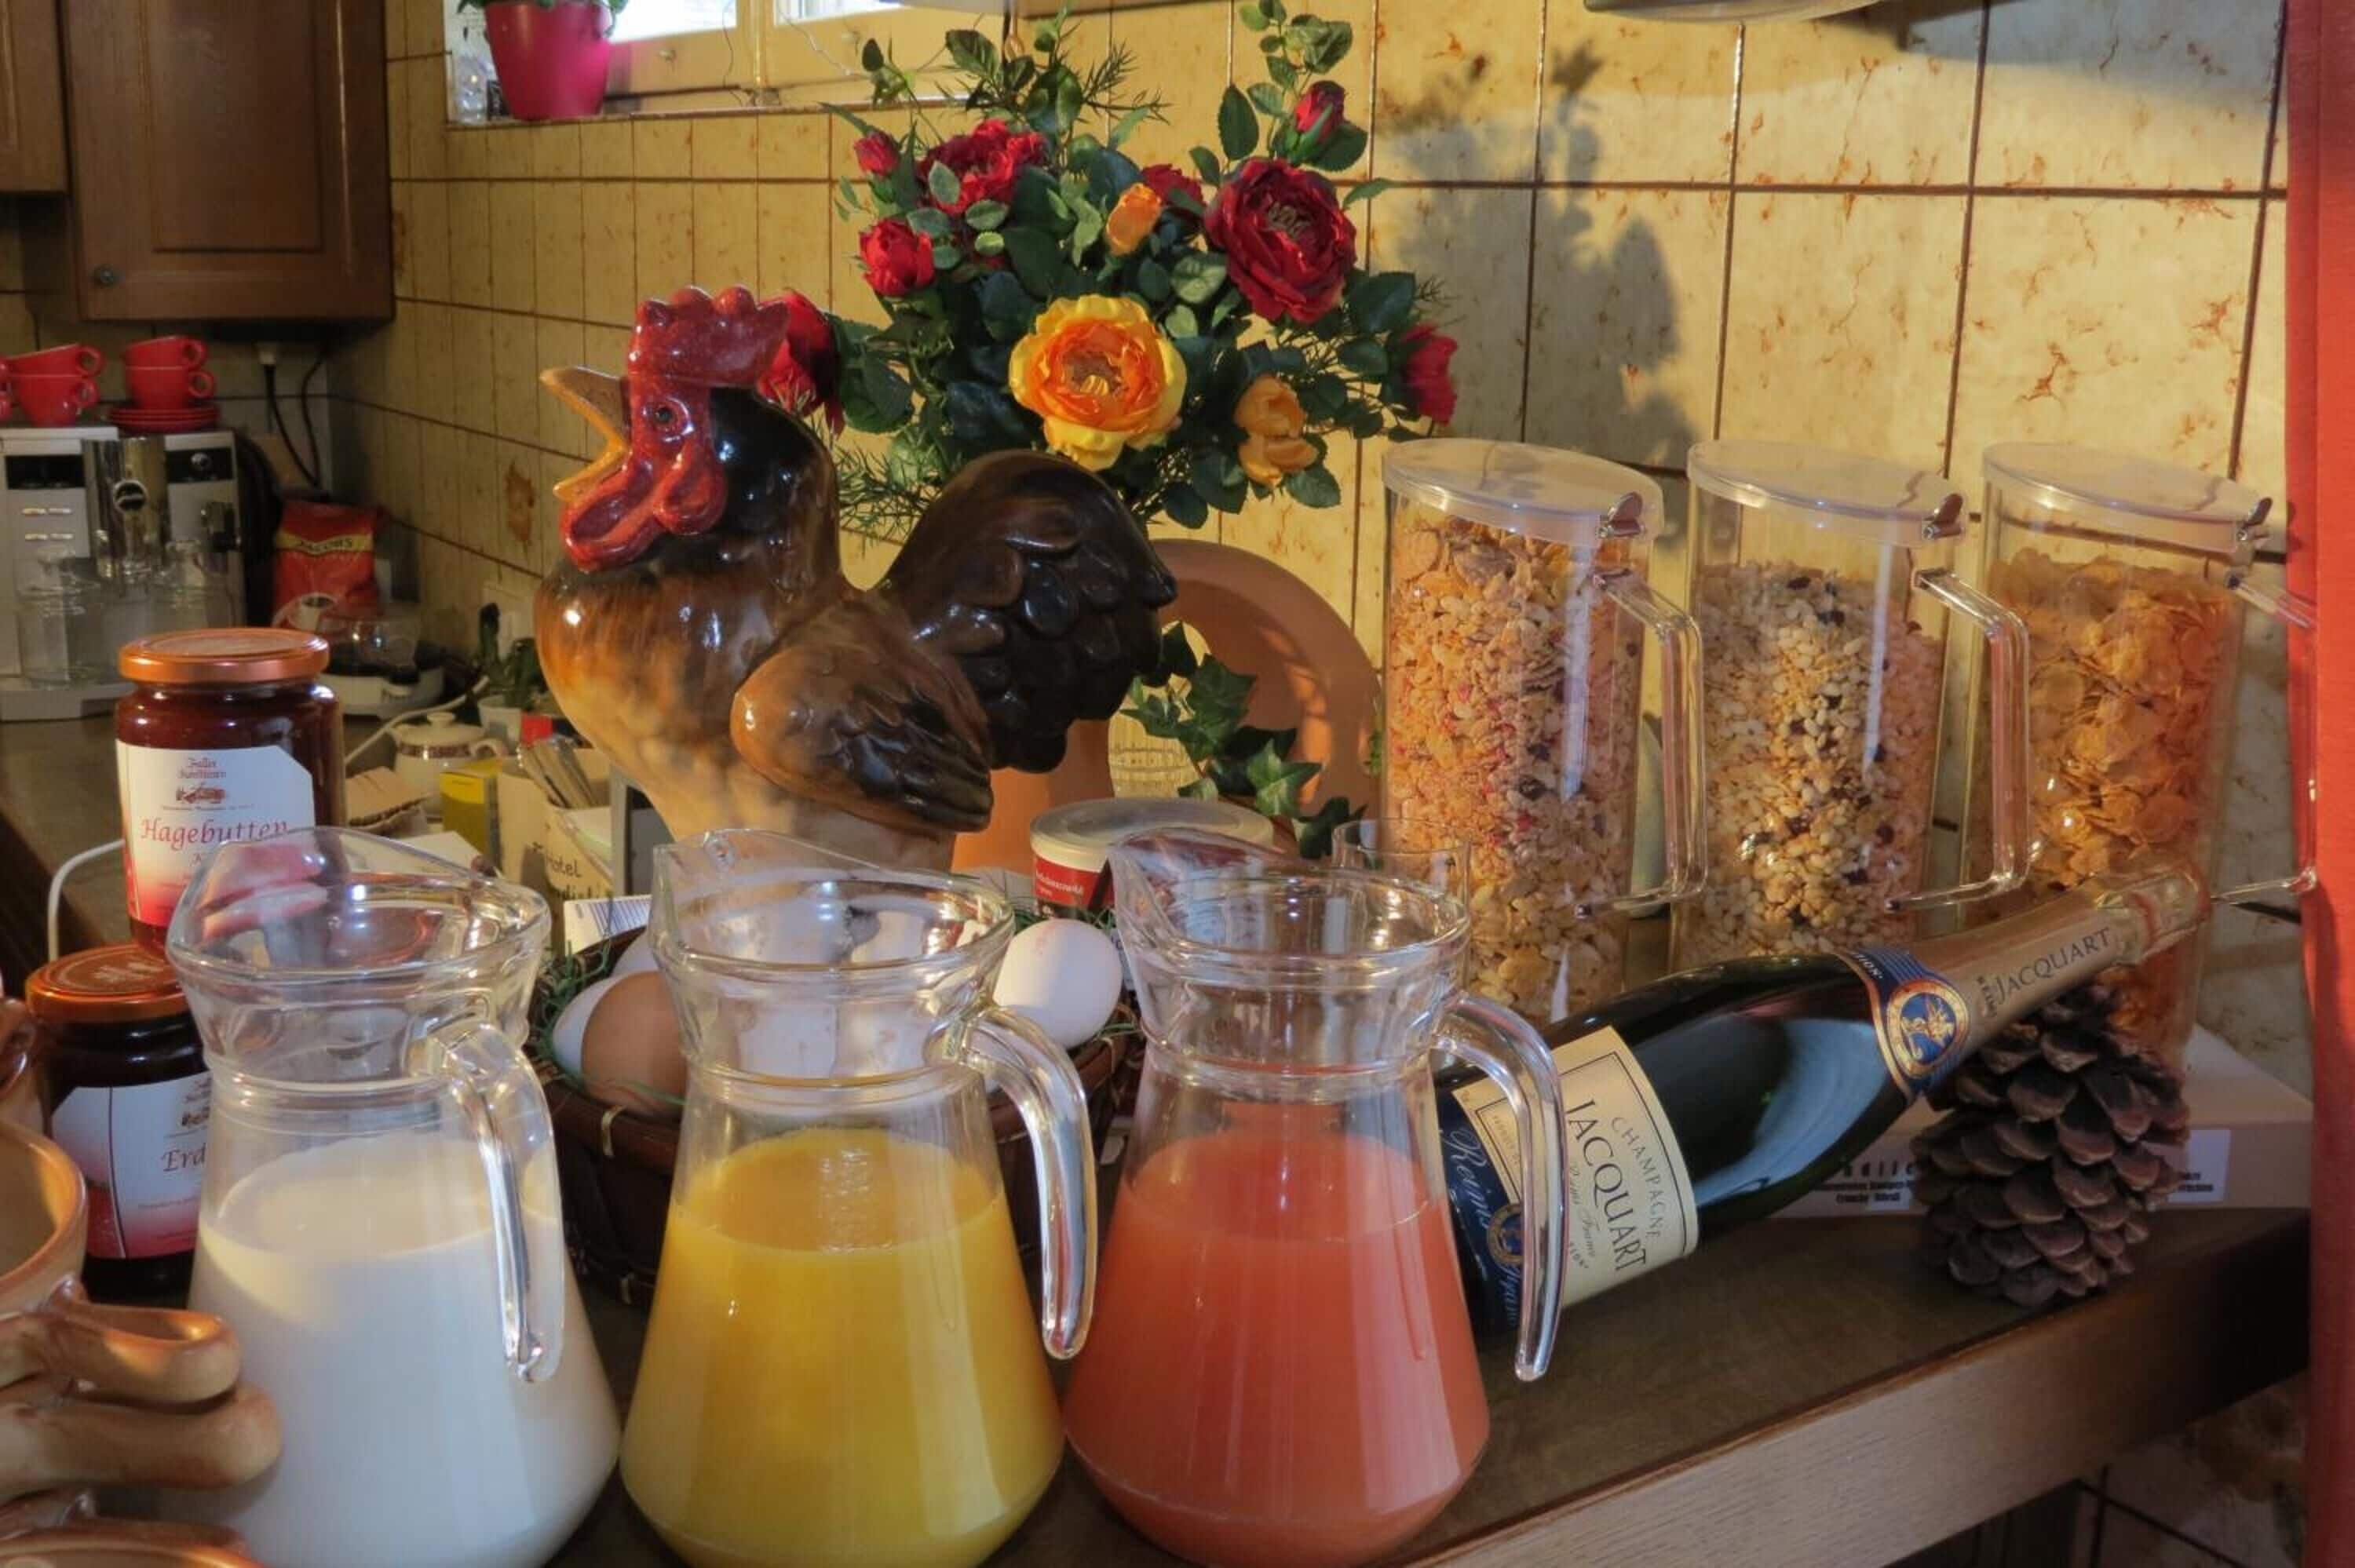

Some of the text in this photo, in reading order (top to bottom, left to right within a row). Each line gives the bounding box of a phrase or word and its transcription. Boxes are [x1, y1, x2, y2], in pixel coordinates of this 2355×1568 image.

[141, 818, 290, 851] Hagebutten
[1995, 927, 2112, 1005] JACQUART
[1566, 1099, 1647, 1271] JACQUART
[1610, 1116, 1663, 1239] CHAMPAGNE
